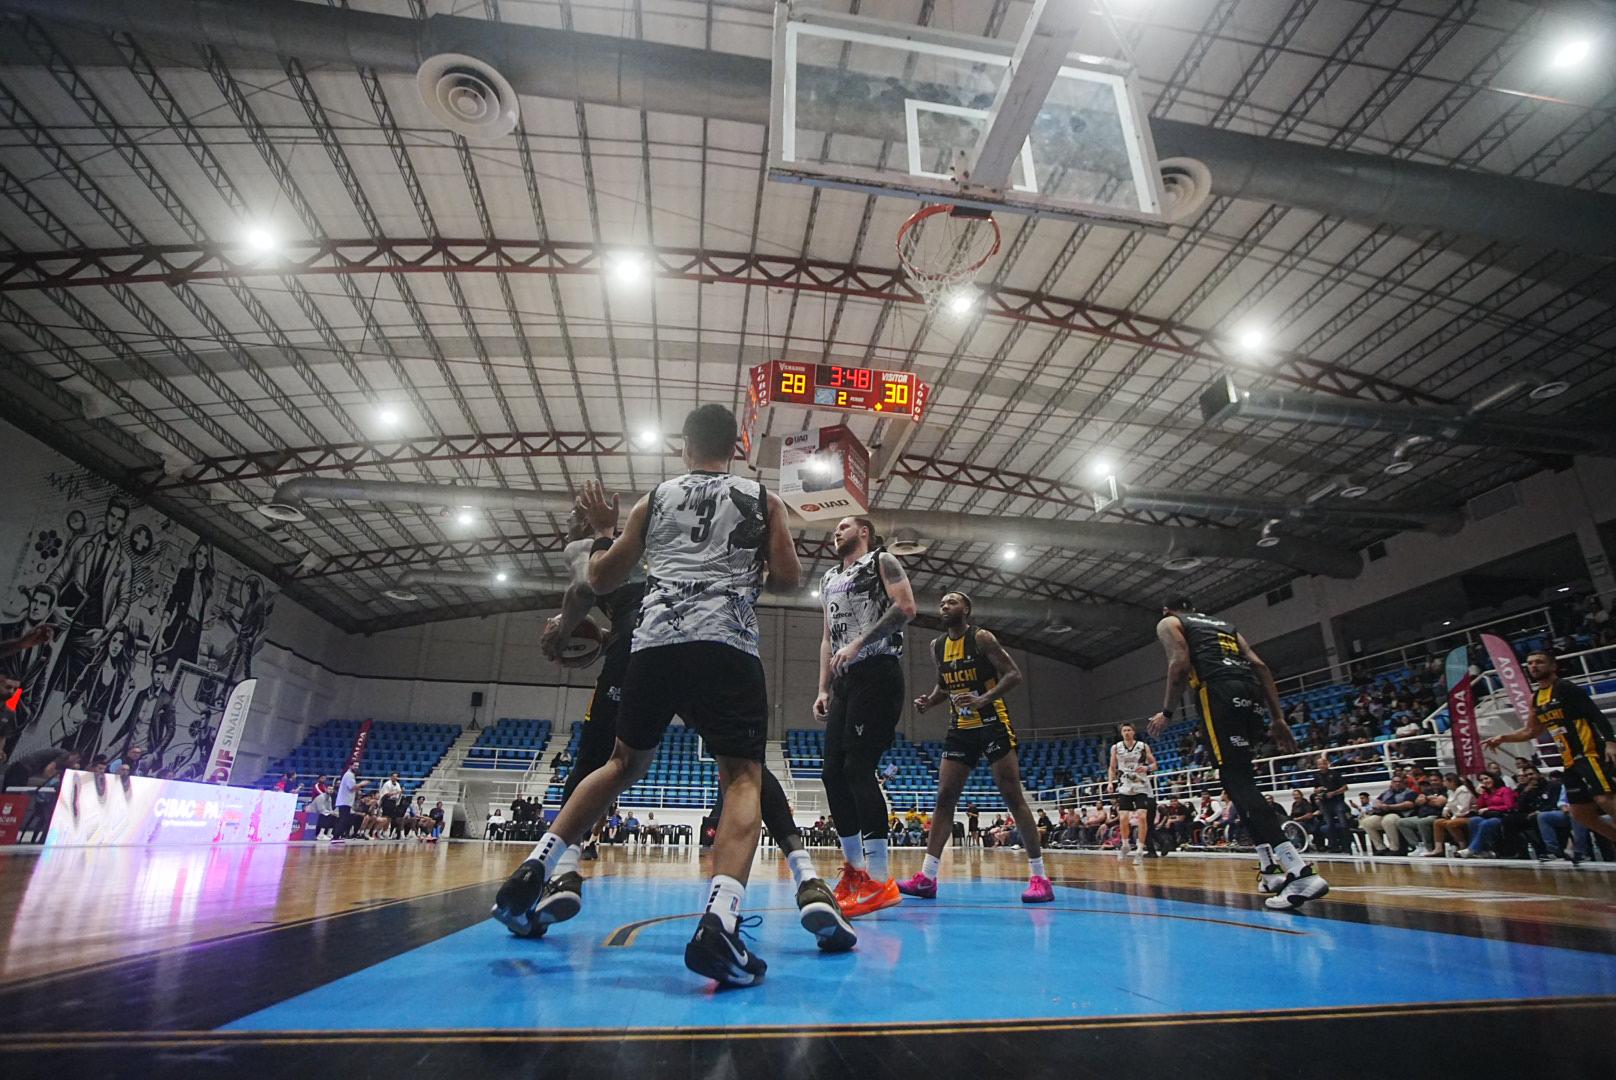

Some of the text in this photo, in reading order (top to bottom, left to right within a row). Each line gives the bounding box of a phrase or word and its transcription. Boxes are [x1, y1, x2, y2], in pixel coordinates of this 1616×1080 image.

[781, 372, 806, 394] 28
[831, 365, 870, 388] 3:48
[881, 372, 908, 383] VISITOR
[837, 391, 848, 405] 2
[883, 383, 908, 404] 30
[794, 434, 808, 443] UAD
[816, 499, 850, 508] UAD
[690, 499, 716, 543] 3
[208, 694, 247, 782] DIF SINALOA
[1453, 690, 1473, 767] SINALOA
